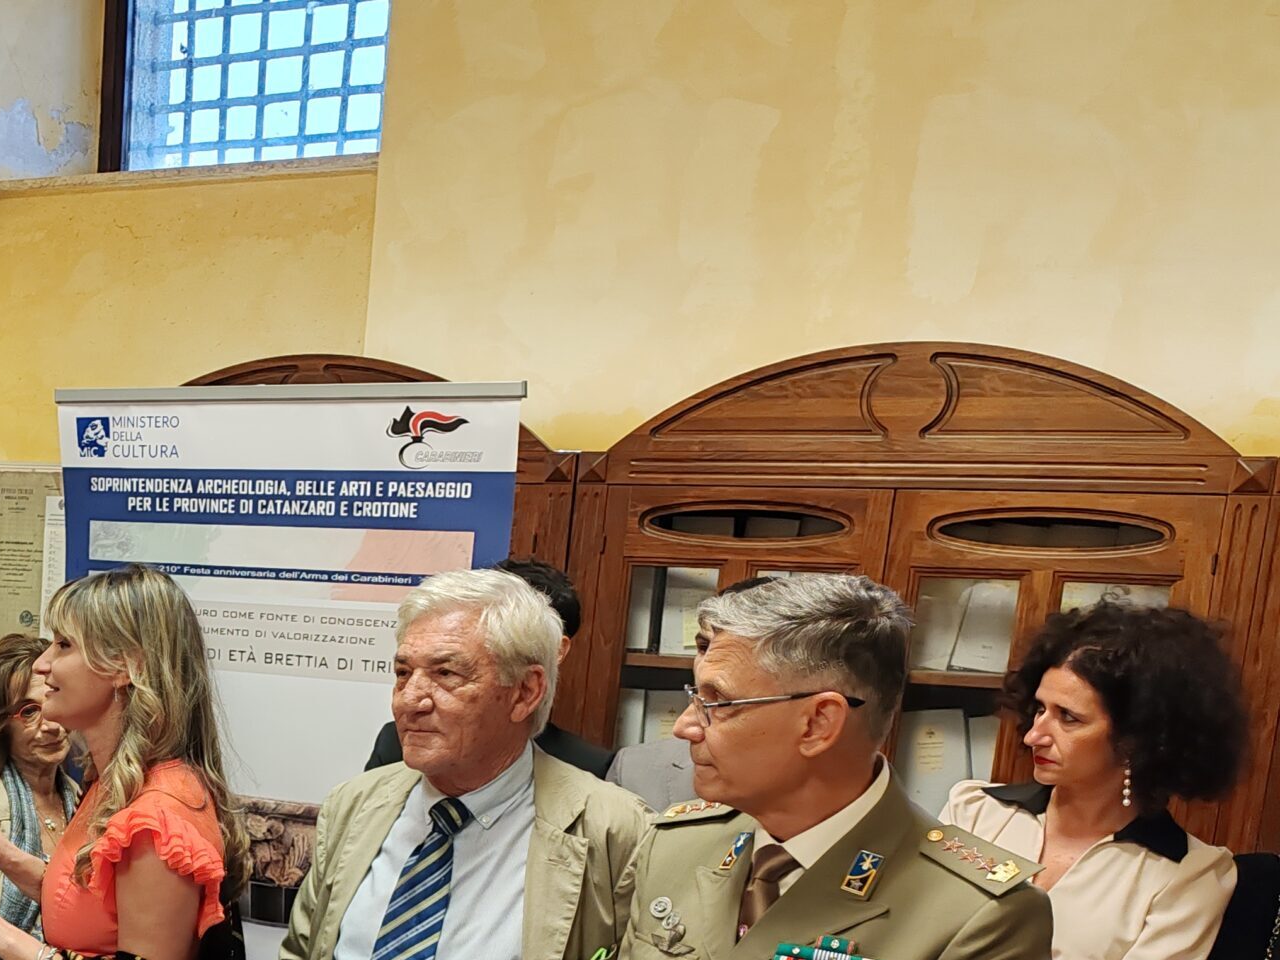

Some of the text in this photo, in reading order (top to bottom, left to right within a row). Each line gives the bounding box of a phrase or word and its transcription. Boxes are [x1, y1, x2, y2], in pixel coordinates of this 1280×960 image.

[112, 416, 180, 429] MINISTERO
[112, 431, 143, 442] DELLA
[112, 444, 180, 459] CULTURA
[414, 450, 484, 463] CARABINIERI
[90, 476, 473, 499] SOPRINTENDENZA ARCHEOLOGIA, BELLE ARTI E PAESAGGIO
[128, 496, 419, 519] PER LE PROVINCE DI CATANZARO E CROTONE
[159, 565, 413, 585] 210° Festa anniversaria dell'Arma dei Carabinieri
[222, 610, 256, 620] COME
[259, 612, 299, 623] FONTE
[303, 615, 316, 624] DI
[320, 616, 398, 629] CONOSCENZ
[255, 630, 267, 639] DI
[271, 631, 376, 646] VALORIZZAZIONE
[207, 647, 221, 660] DI
[228, 645, 257, 664] ETÀ
[264, 652, 329, 669] BRETTIA
[337, 658, 354, 672] DI
